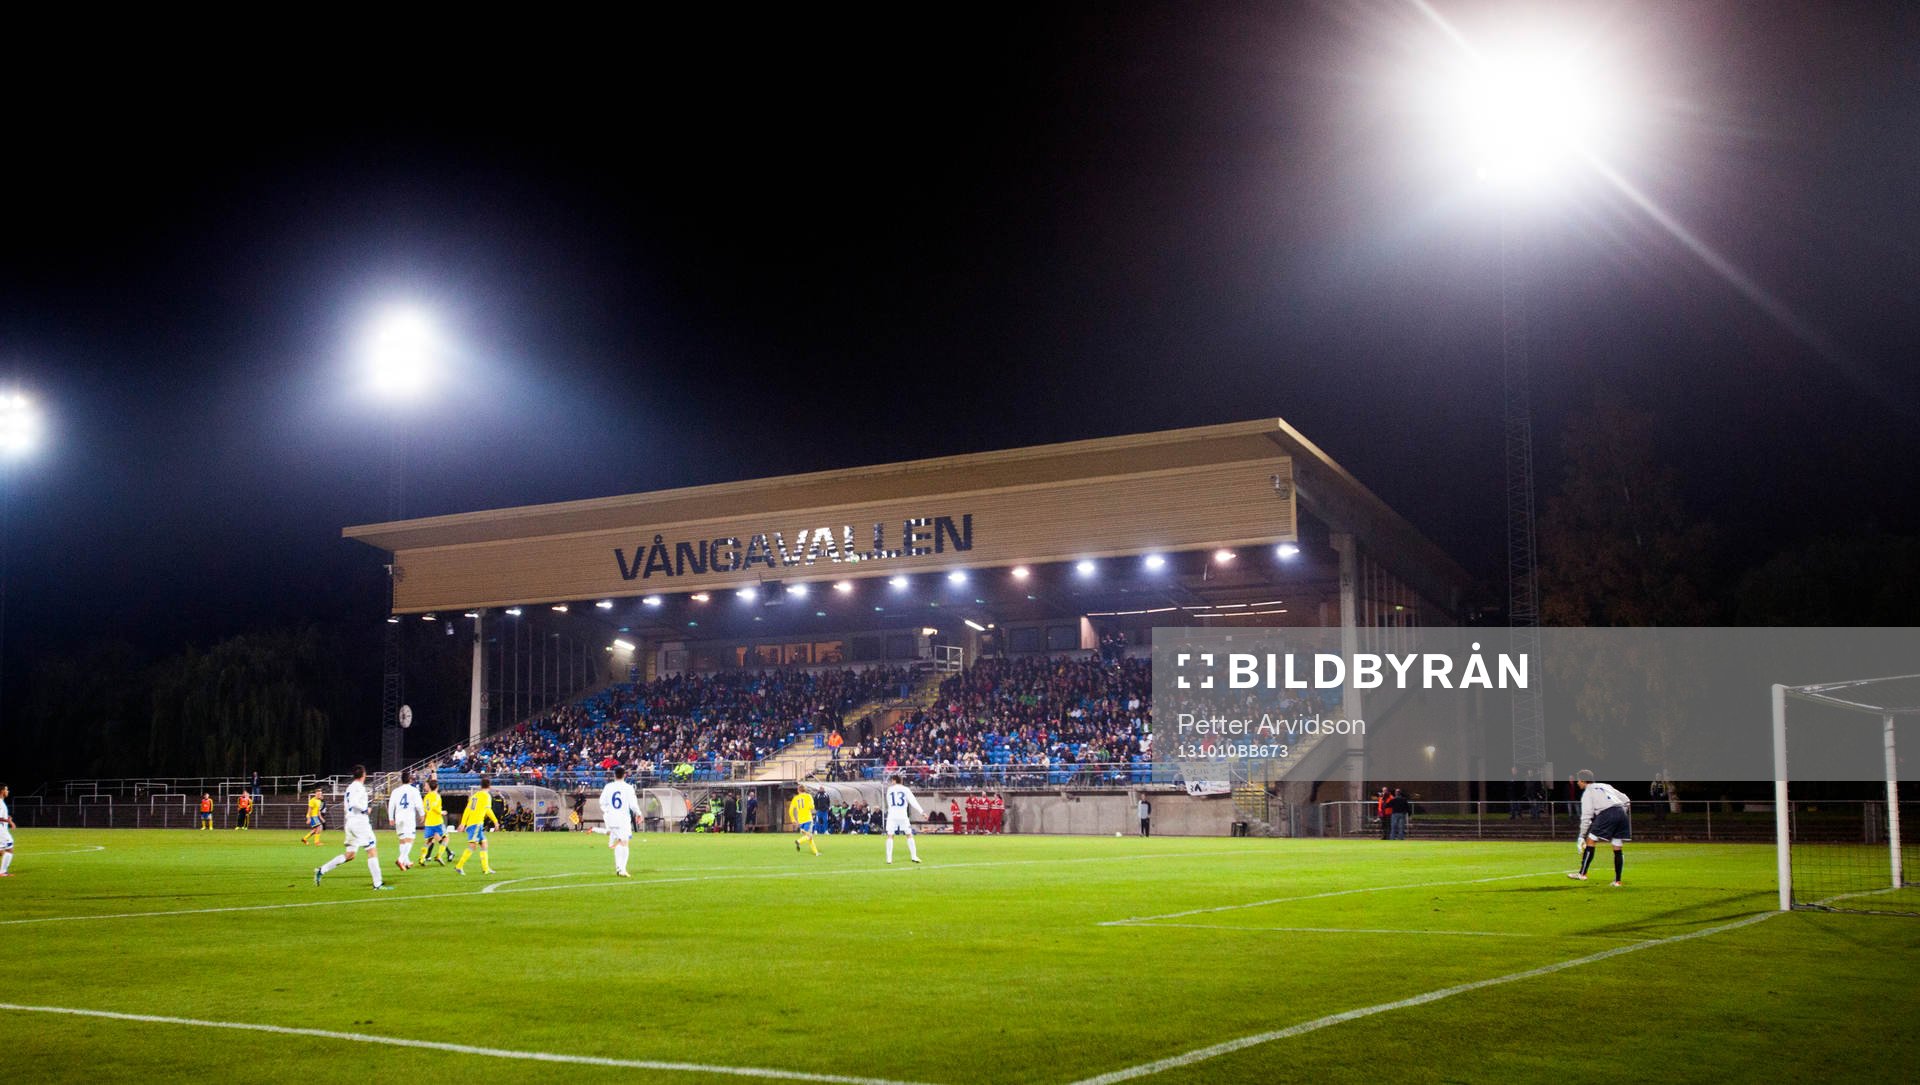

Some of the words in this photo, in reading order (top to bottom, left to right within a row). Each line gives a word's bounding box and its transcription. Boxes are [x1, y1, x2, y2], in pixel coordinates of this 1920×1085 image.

[614, 513, 974, 582] VÅNGAVALLEN
[400, 793, 409, 809] 4
[611, 791, 622, 809] 6
[890, 791, 905, 806] 13
